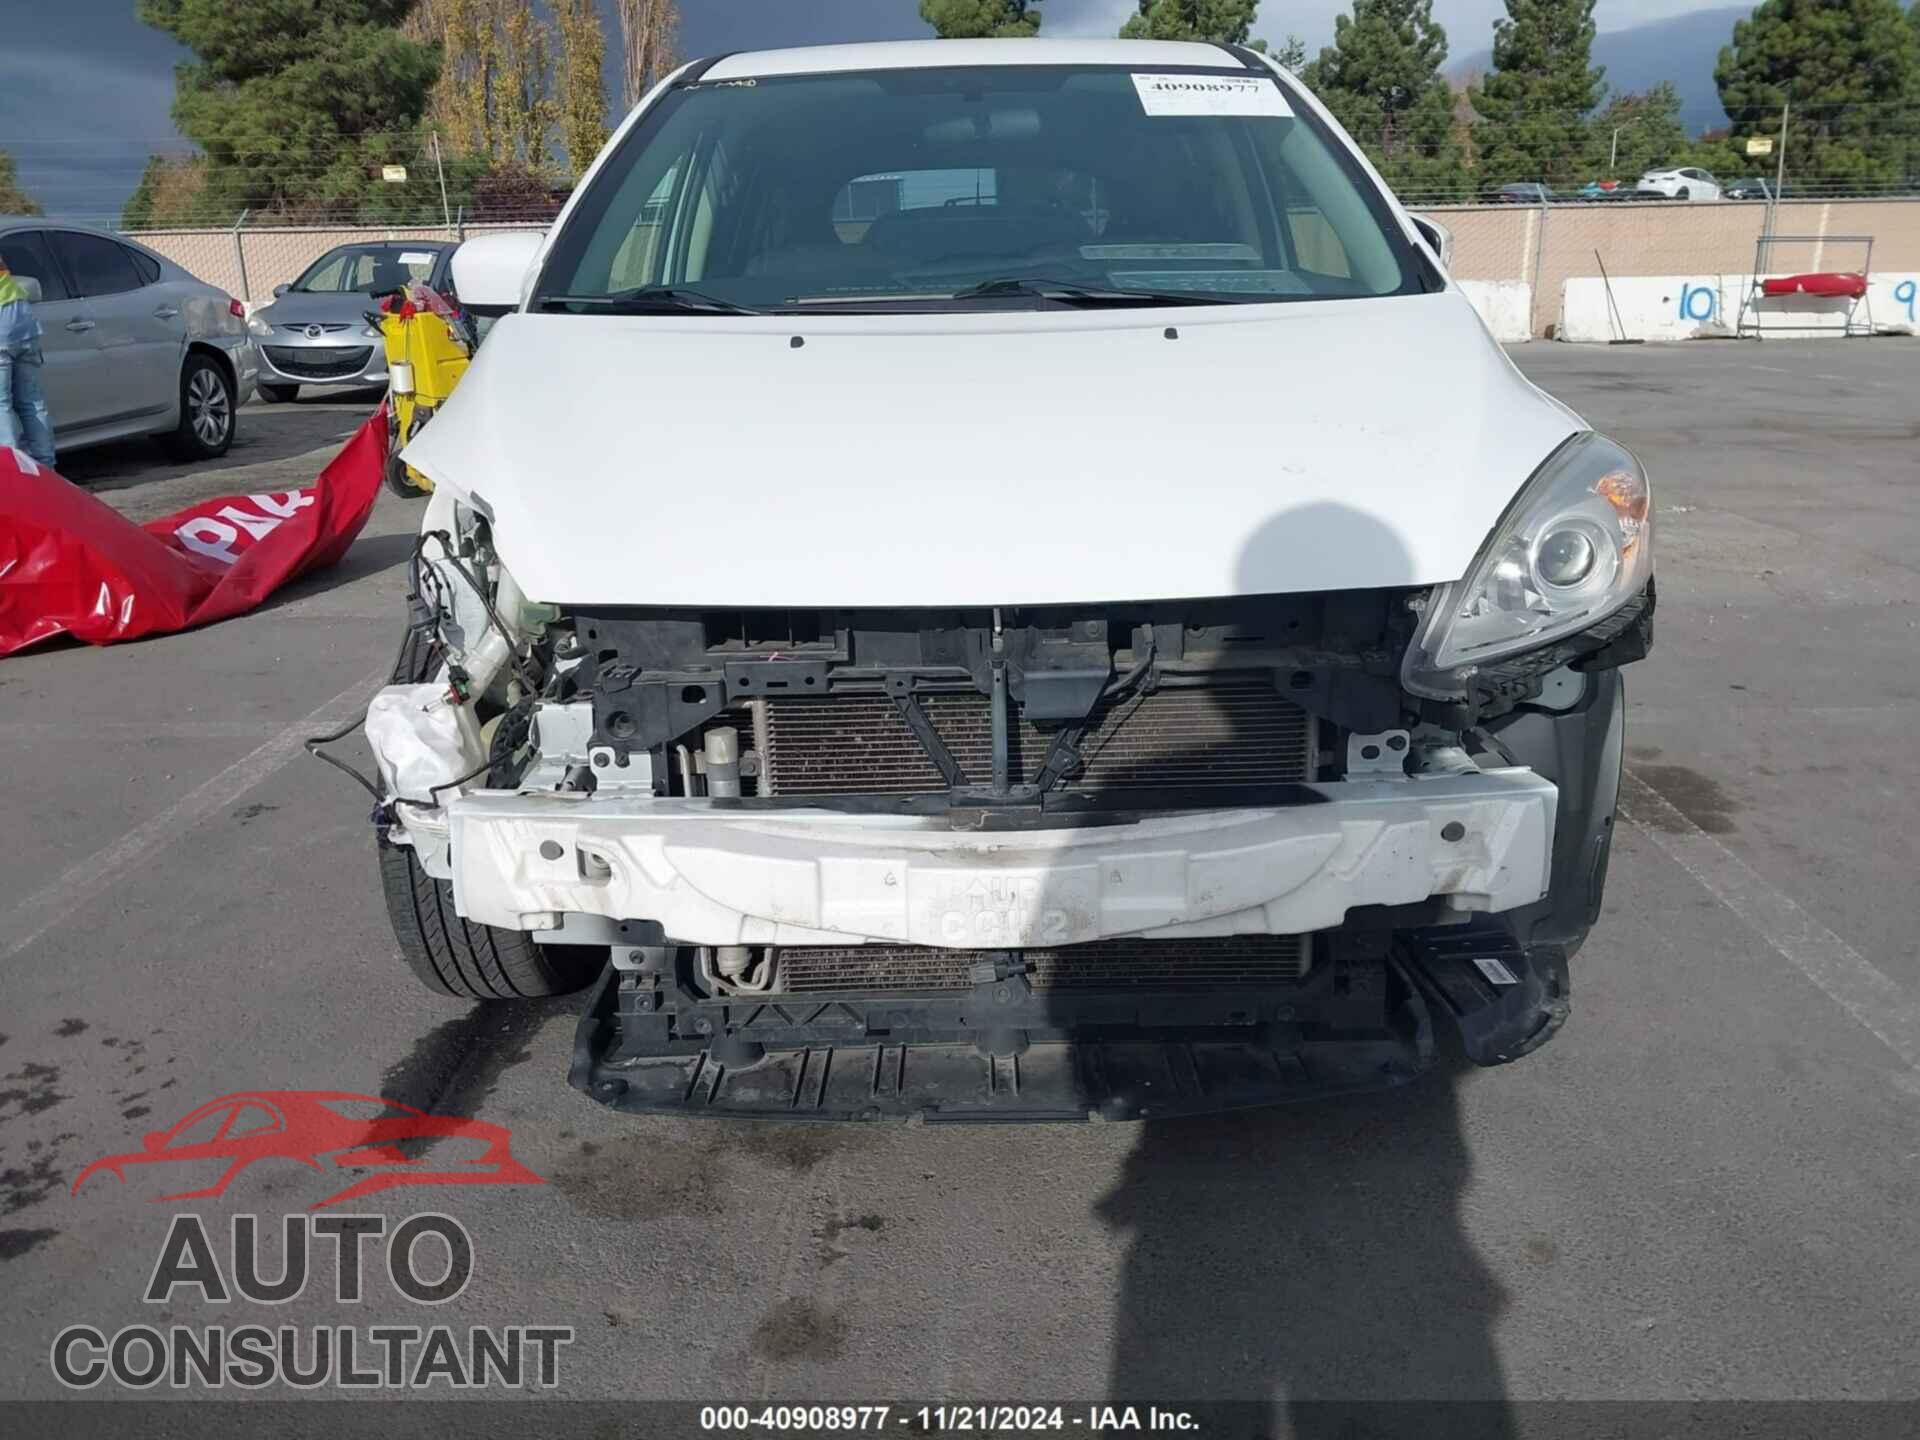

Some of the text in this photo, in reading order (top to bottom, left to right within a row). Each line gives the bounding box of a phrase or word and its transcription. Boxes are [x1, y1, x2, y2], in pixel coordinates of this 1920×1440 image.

[1151, 82, 1260, 94] 40908977
[1679, 283, 1717, 321] 10
[1895, 280, 1916, 322] 9
